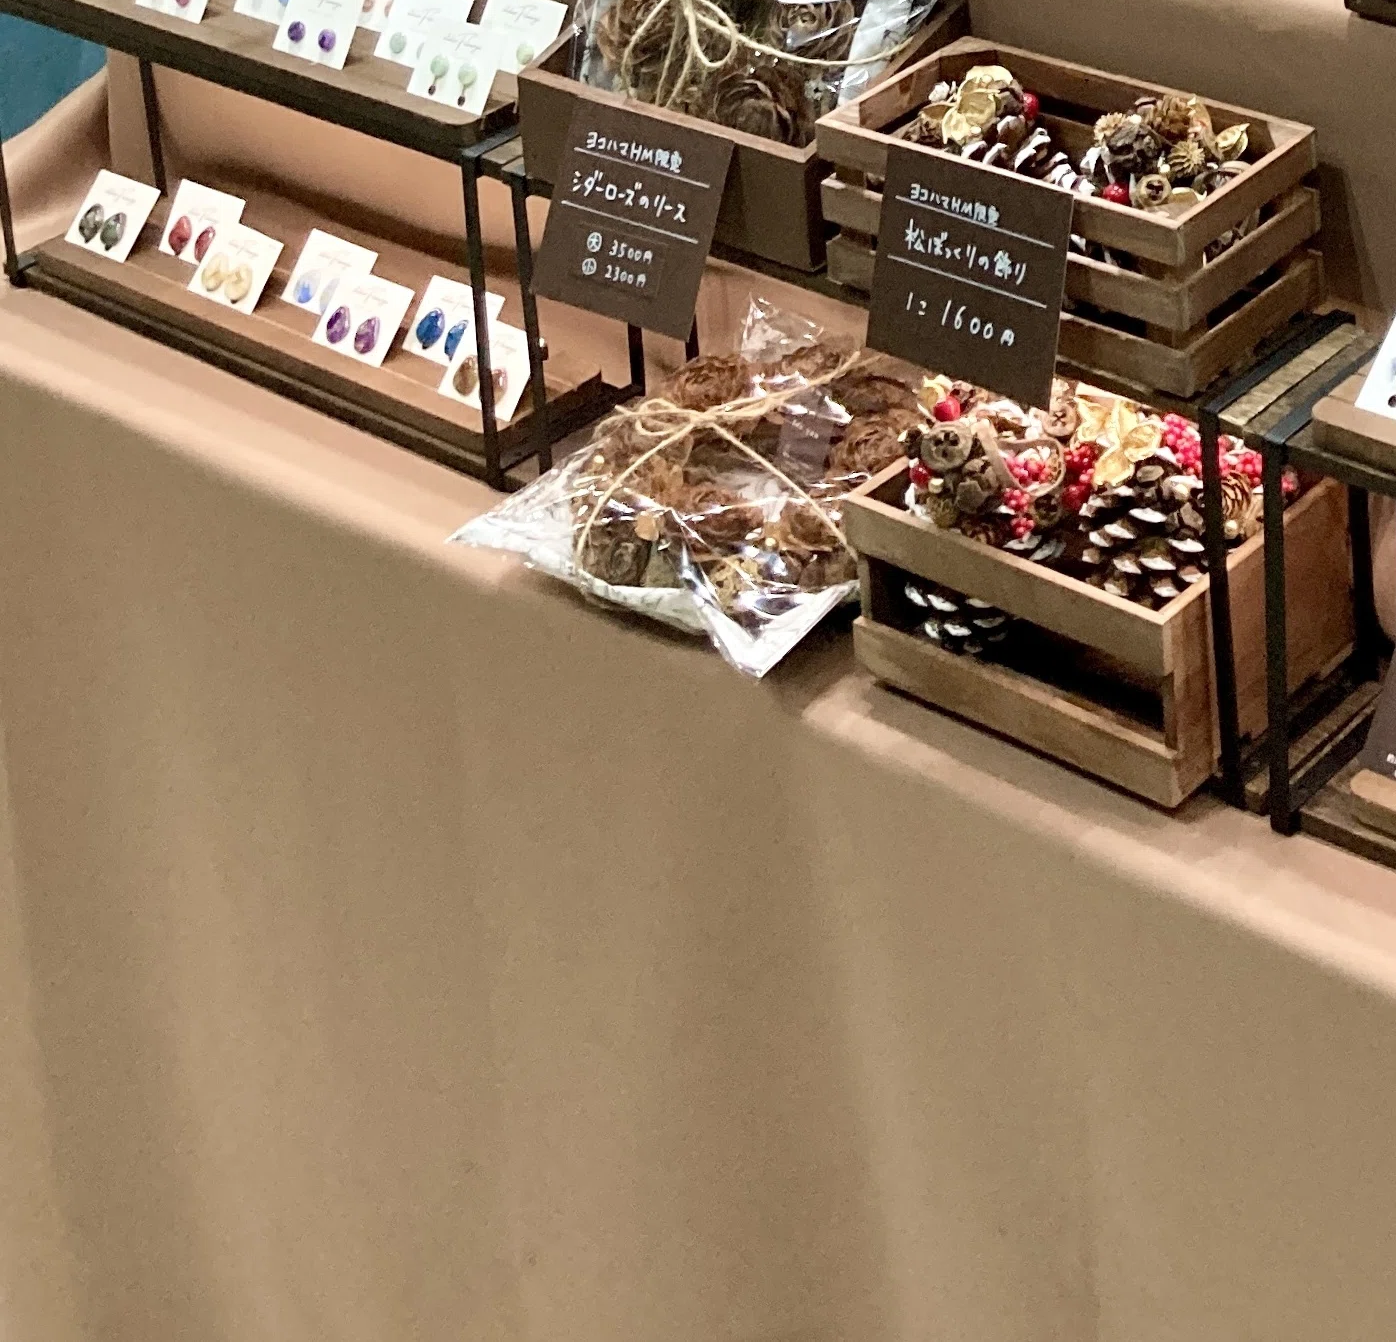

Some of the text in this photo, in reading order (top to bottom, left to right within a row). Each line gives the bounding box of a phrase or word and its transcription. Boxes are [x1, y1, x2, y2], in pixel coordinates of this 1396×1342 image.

[586, 131, 683, 173] ヨコハマHM限定
[572, 169, 687, 223] シダーローズのリース
[910, 183, 1001, 227] ヨコハマHM限定
[608, 238, 653, 264] 3500円
[904, 218, 1027, 286] 松ぼっくりの飾り
[604, 264, 647, 288] 2300円
[940, 299, 1016, 347] 1600円
